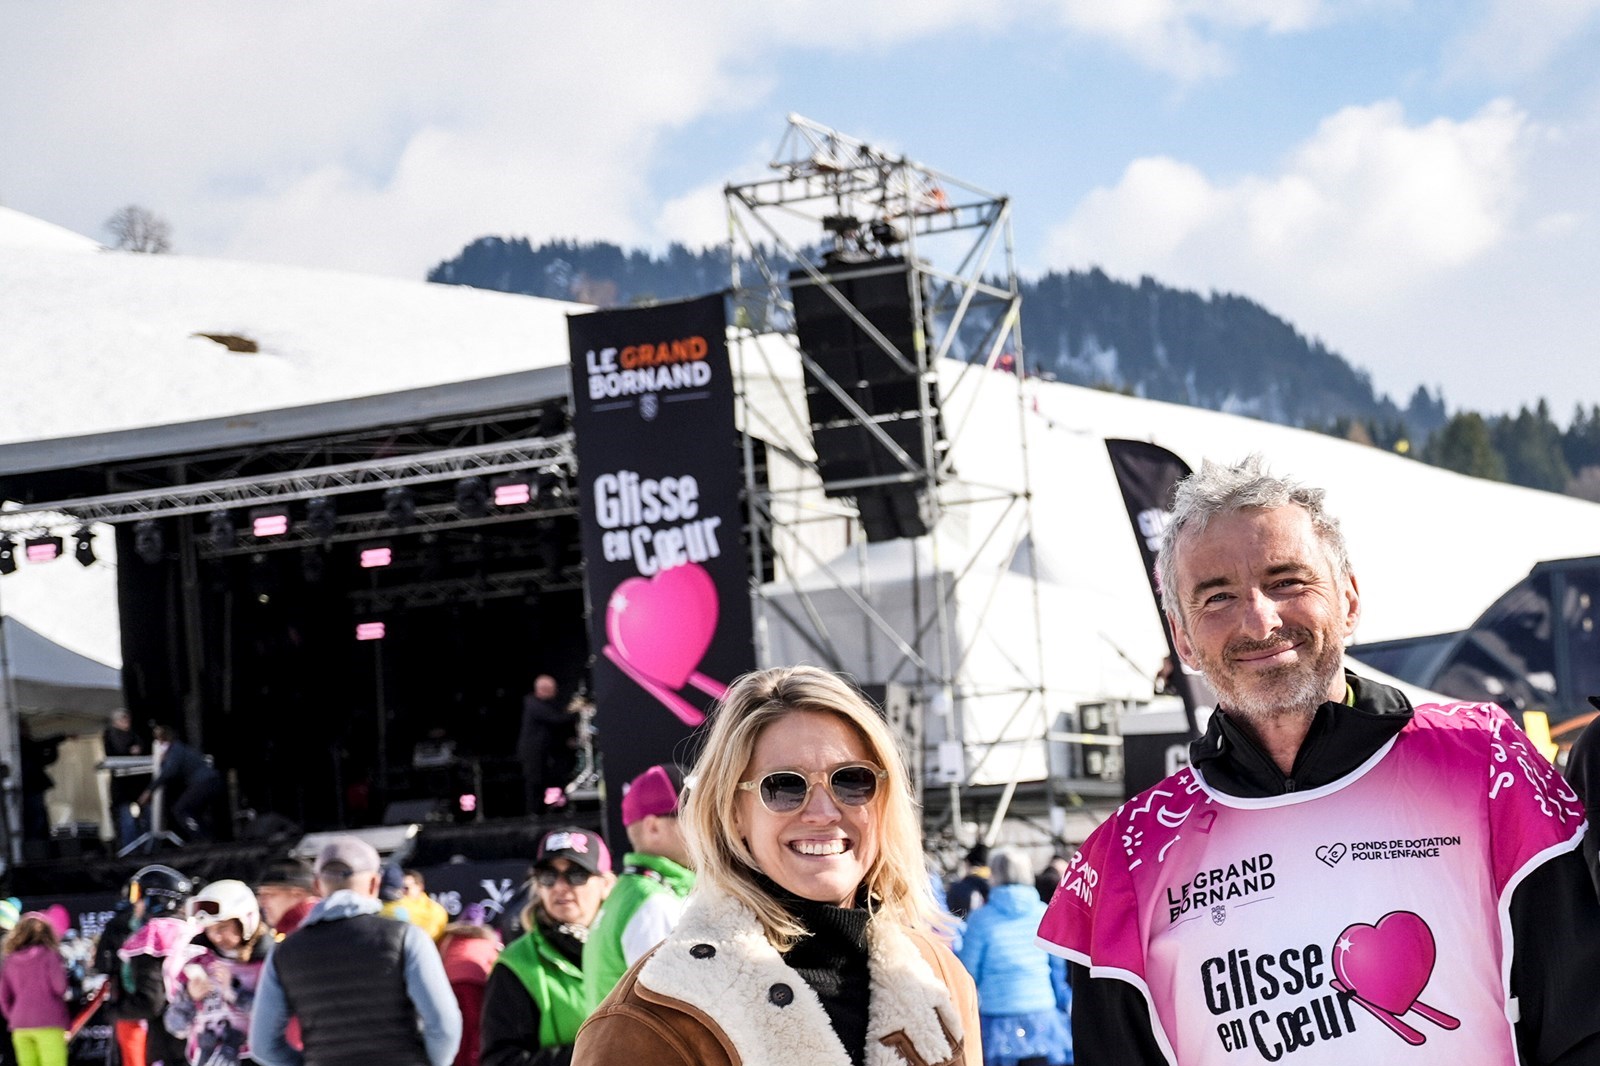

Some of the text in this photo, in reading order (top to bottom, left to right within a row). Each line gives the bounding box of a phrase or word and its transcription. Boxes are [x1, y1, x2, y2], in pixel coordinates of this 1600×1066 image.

[586, 336, 708, 374] LE GRAND
[588, 361, 712, 400] BORNAND
[594, 470, 699, 528] Glisse
[602, 531, 632, 562] en
[1351, 836, 1461, 851] FONDS DE DOTATION
[1352, 847, 1440, 861] POUR L'ENFANCE
[1070, 850, 1099, 888] RAND
[1167, 853, 1273, 905] LE GRAND
[1169, 872, 1275, 924] BORNAND
[1200, 944, 1324, 1015] Glisse
[1217, 1018, 1248, 1052] en
